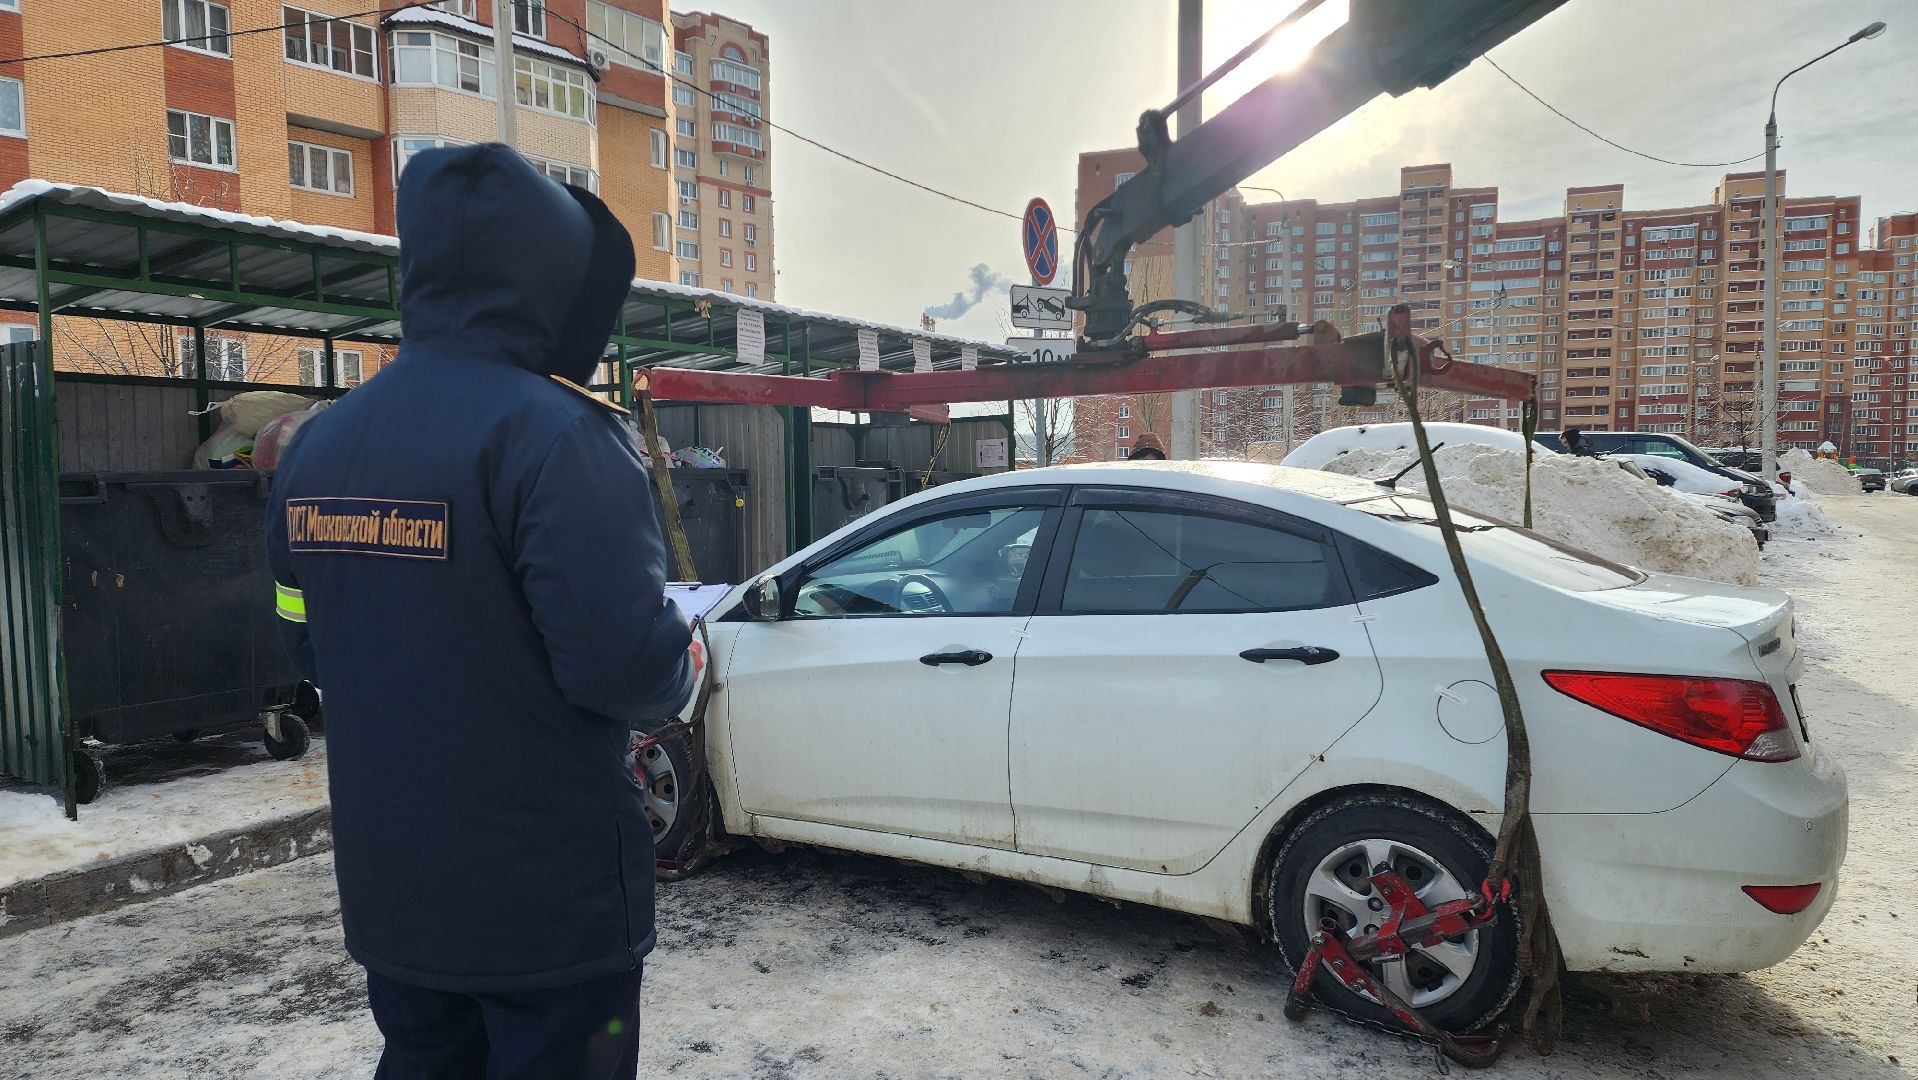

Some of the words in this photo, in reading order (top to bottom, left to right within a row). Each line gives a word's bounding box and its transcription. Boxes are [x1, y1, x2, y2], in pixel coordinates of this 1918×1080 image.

[1032, 348, 1054, 363] 10
[307, 505, 380, 545] Московской
[382, 509, 443, 549] области
